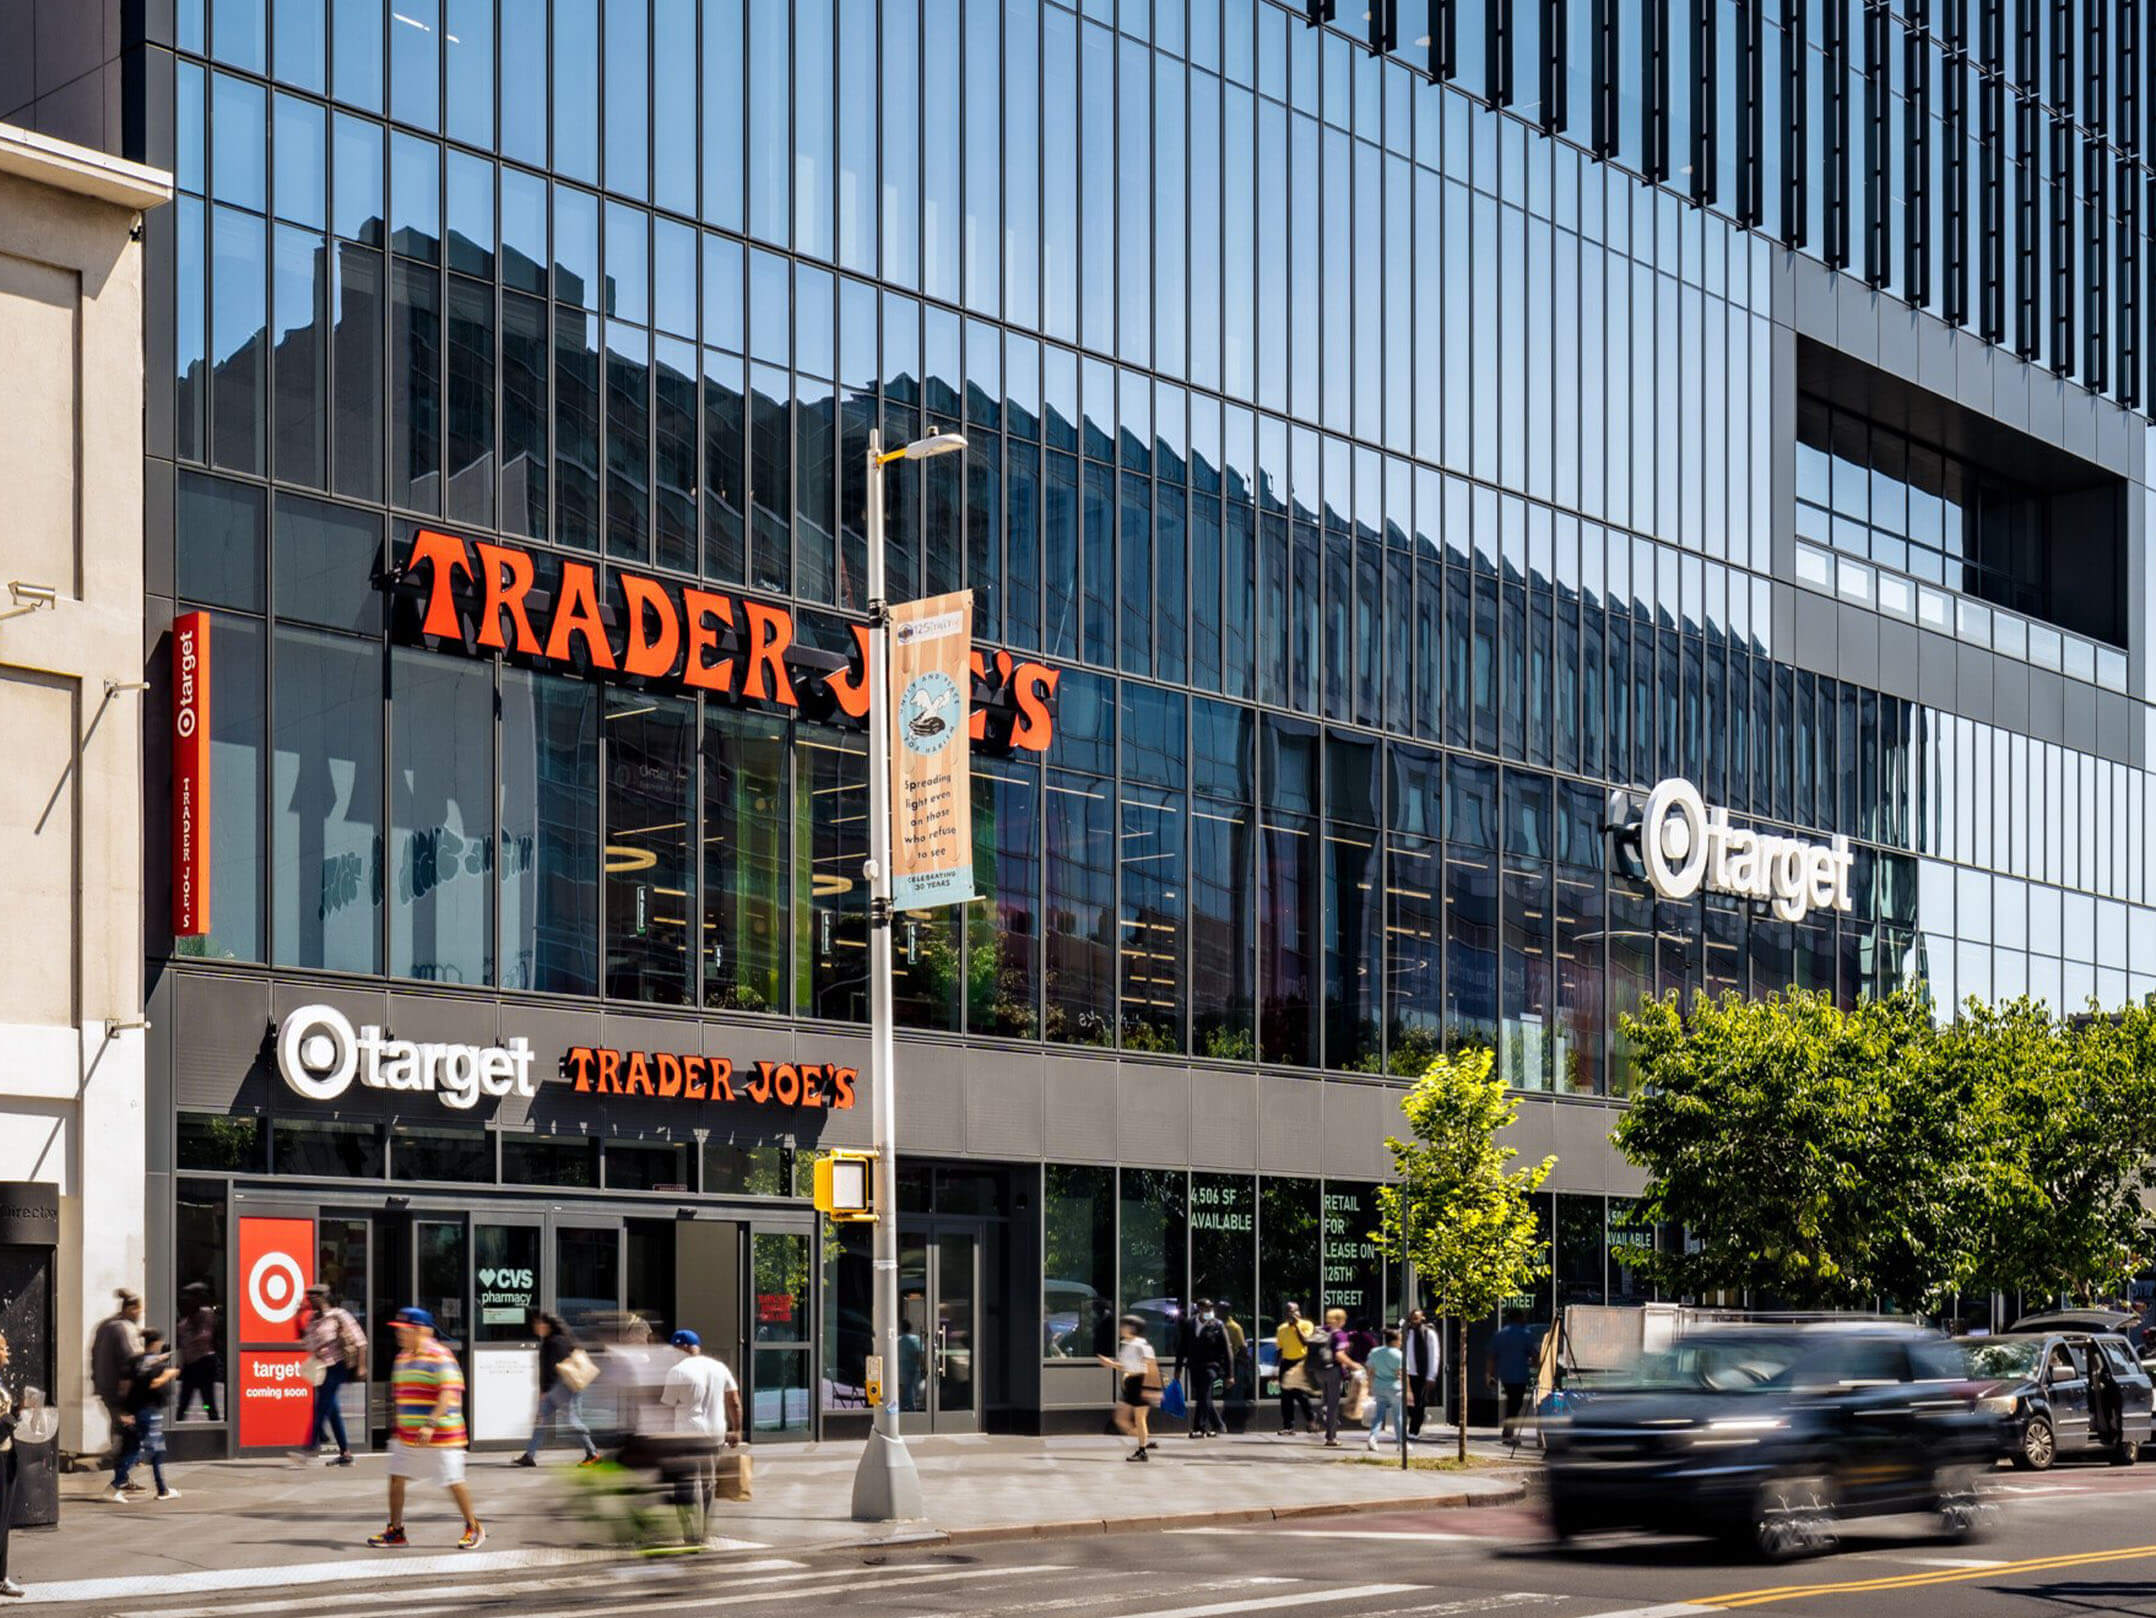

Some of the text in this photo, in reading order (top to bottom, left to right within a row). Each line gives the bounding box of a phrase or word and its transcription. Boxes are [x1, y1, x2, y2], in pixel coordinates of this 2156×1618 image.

[409, 530, 798, 707] TRADER
[179, 630, 197, 706] target
[904, 774, 951, 793] Spreading
[905, 791, 951, 811] light even
[183, 777, 191, 862] TRADER
[910, 808, 950, 827] on those
[904, 825, 957, 844] who refuse
[918, 847, 946, 859] to see
[1705, 806, 1854, 922] target
[908, 870, 956, 884] CELEBRATING
[927, 879, 951, 889] YEARS
[356, 1025, 535, 1109] target
[568, 1047, 858, 1110] TRADER JOE'S
[1191, 1187, 1237, 1206] 4,506 SF
[1324, 1195, 1360, 1211] RETAIL
[1191, 1212, 1252, 1230] AVAILABLE
[1324, 1218, 1345, 1234] FOR
[1324, 1243, 1374, 1259] LEASE ON
[497, 1268, 533, 1289] CVS
[482, 1290, 532, 1306] pharmacy
[1324, 1290, 1363, 1305] STREET
[1501, 1294, 1536, 1308] STREET
[253, 1360, 301, 1381] target
[246, 1386, 308, 1400] coming soon
